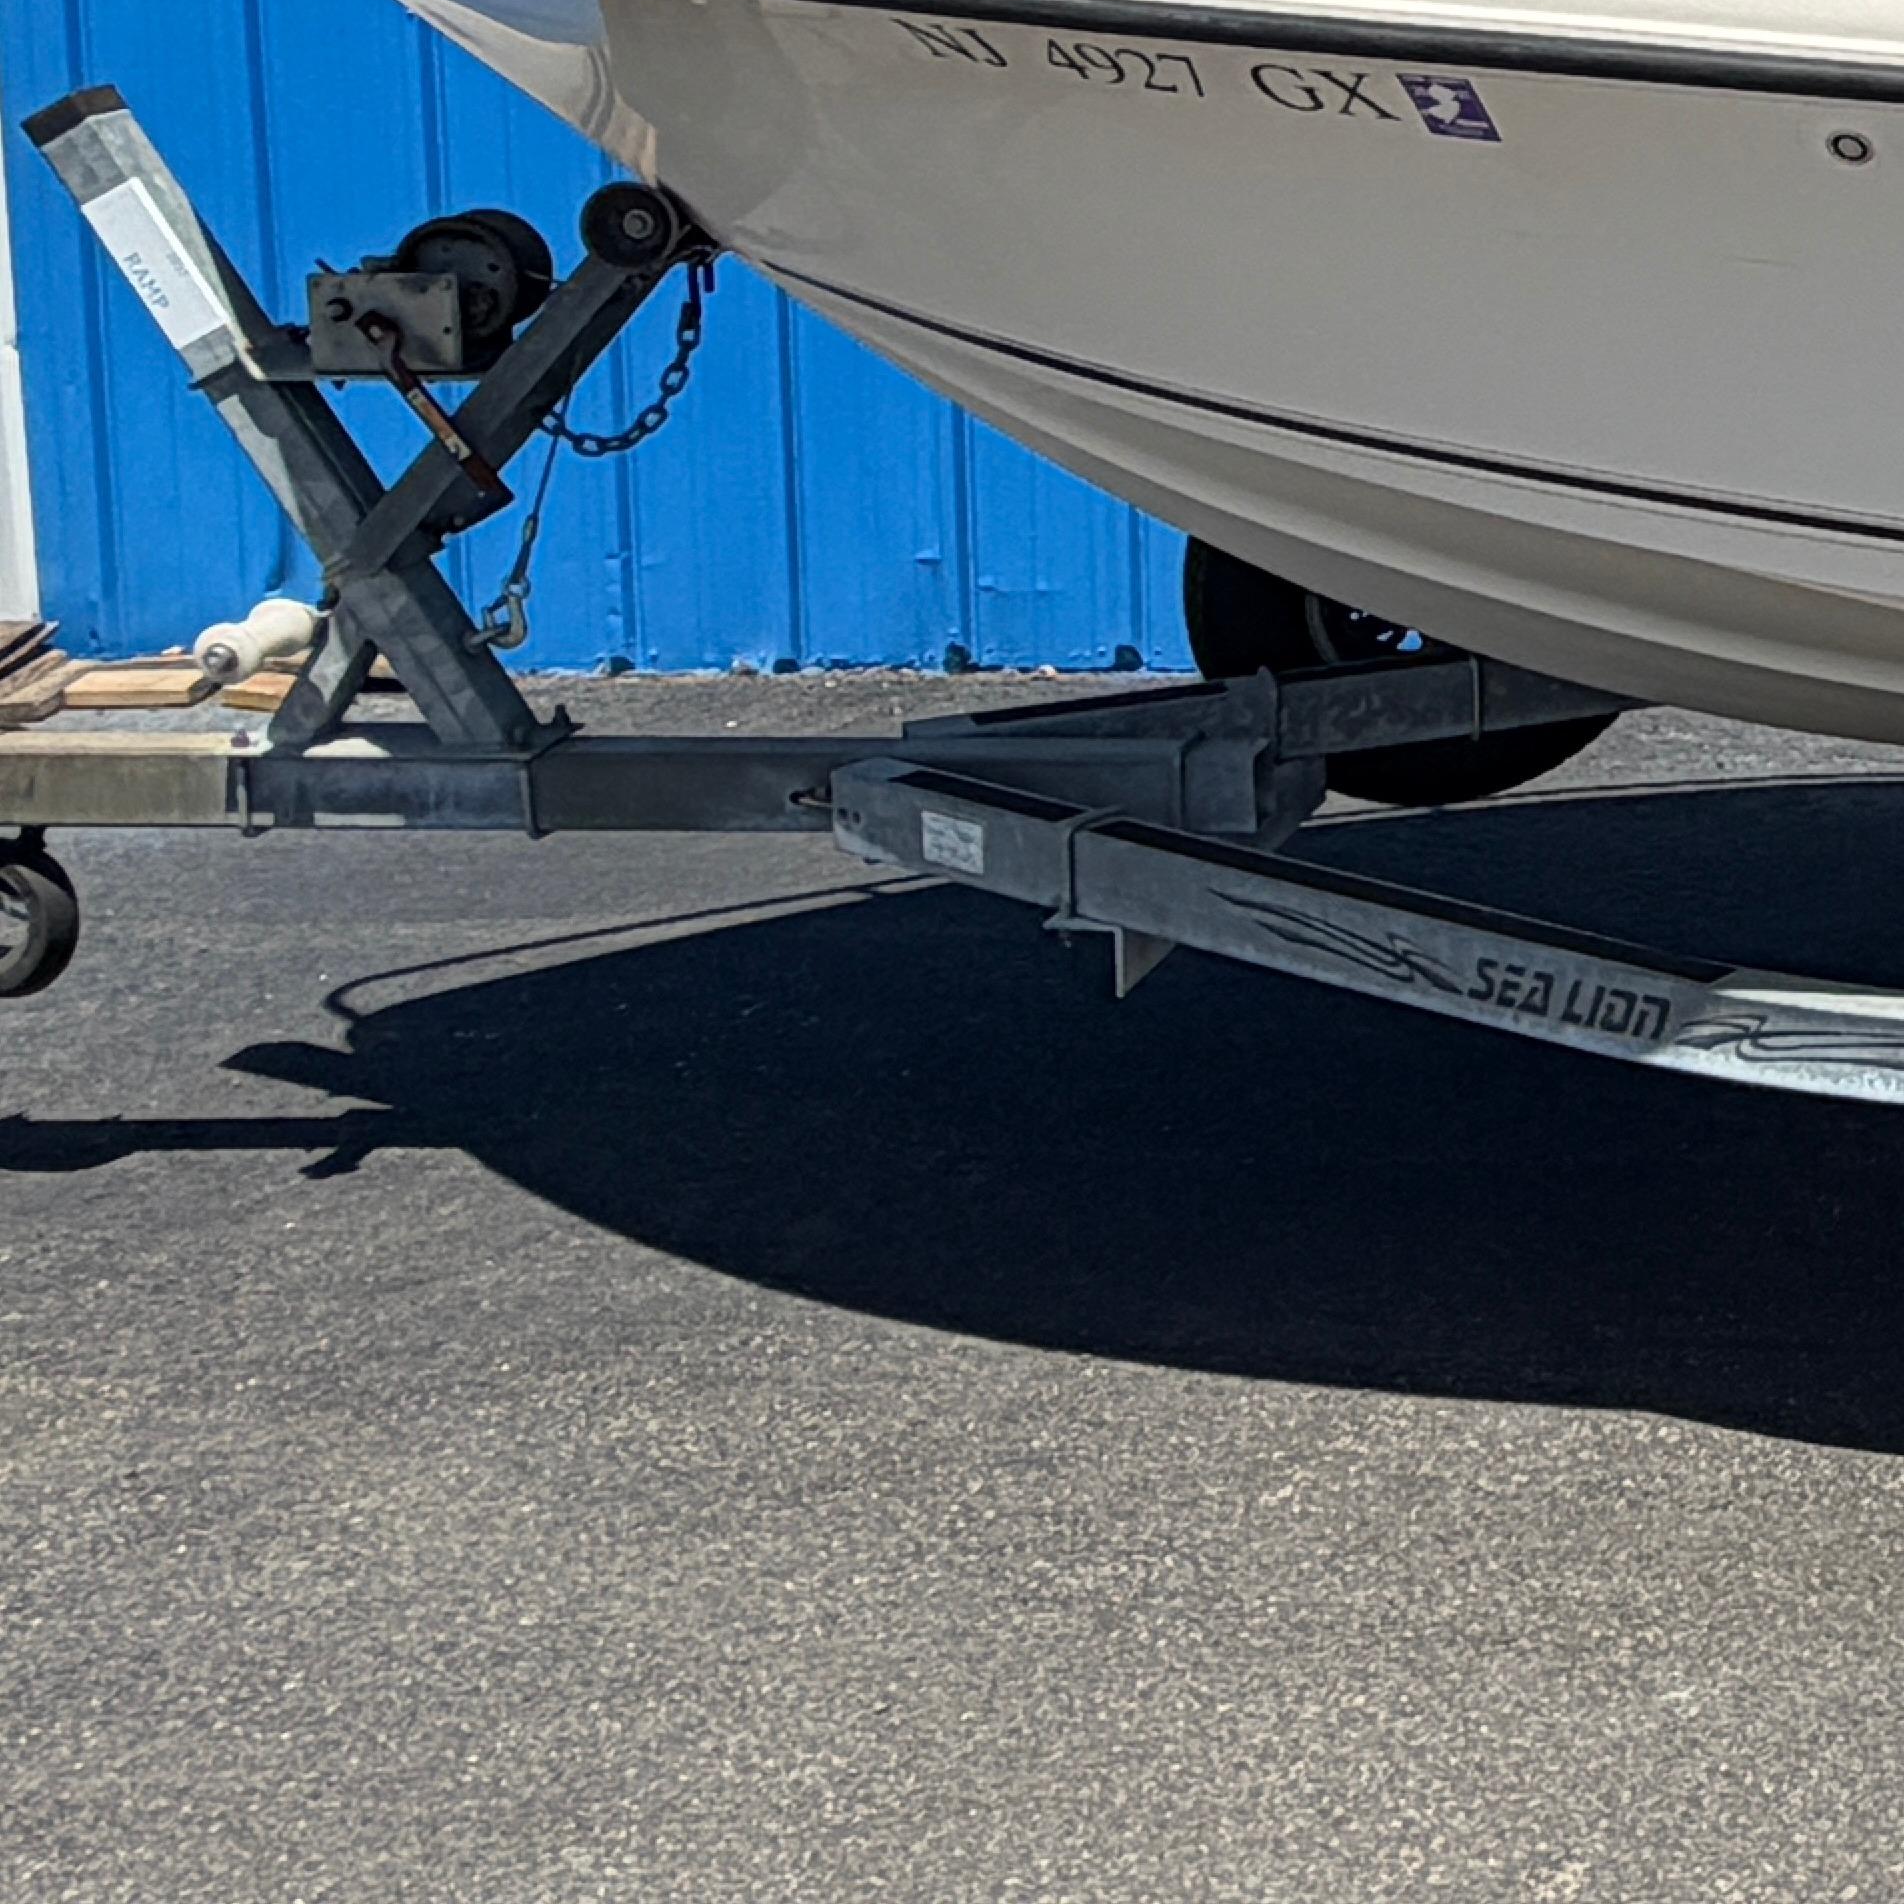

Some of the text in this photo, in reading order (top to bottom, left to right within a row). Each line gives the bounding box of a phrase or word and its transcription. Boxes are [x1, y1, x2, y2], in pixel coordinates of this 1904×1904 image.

[892, 18, 1008, 68] NJ
[1047, 38, 1205, 98] 4927
[1251, 63, 1401, 121] GX
[123, 252, 170, 307] RAMP
[1466, 957, 1671, 1040] SEA LION
